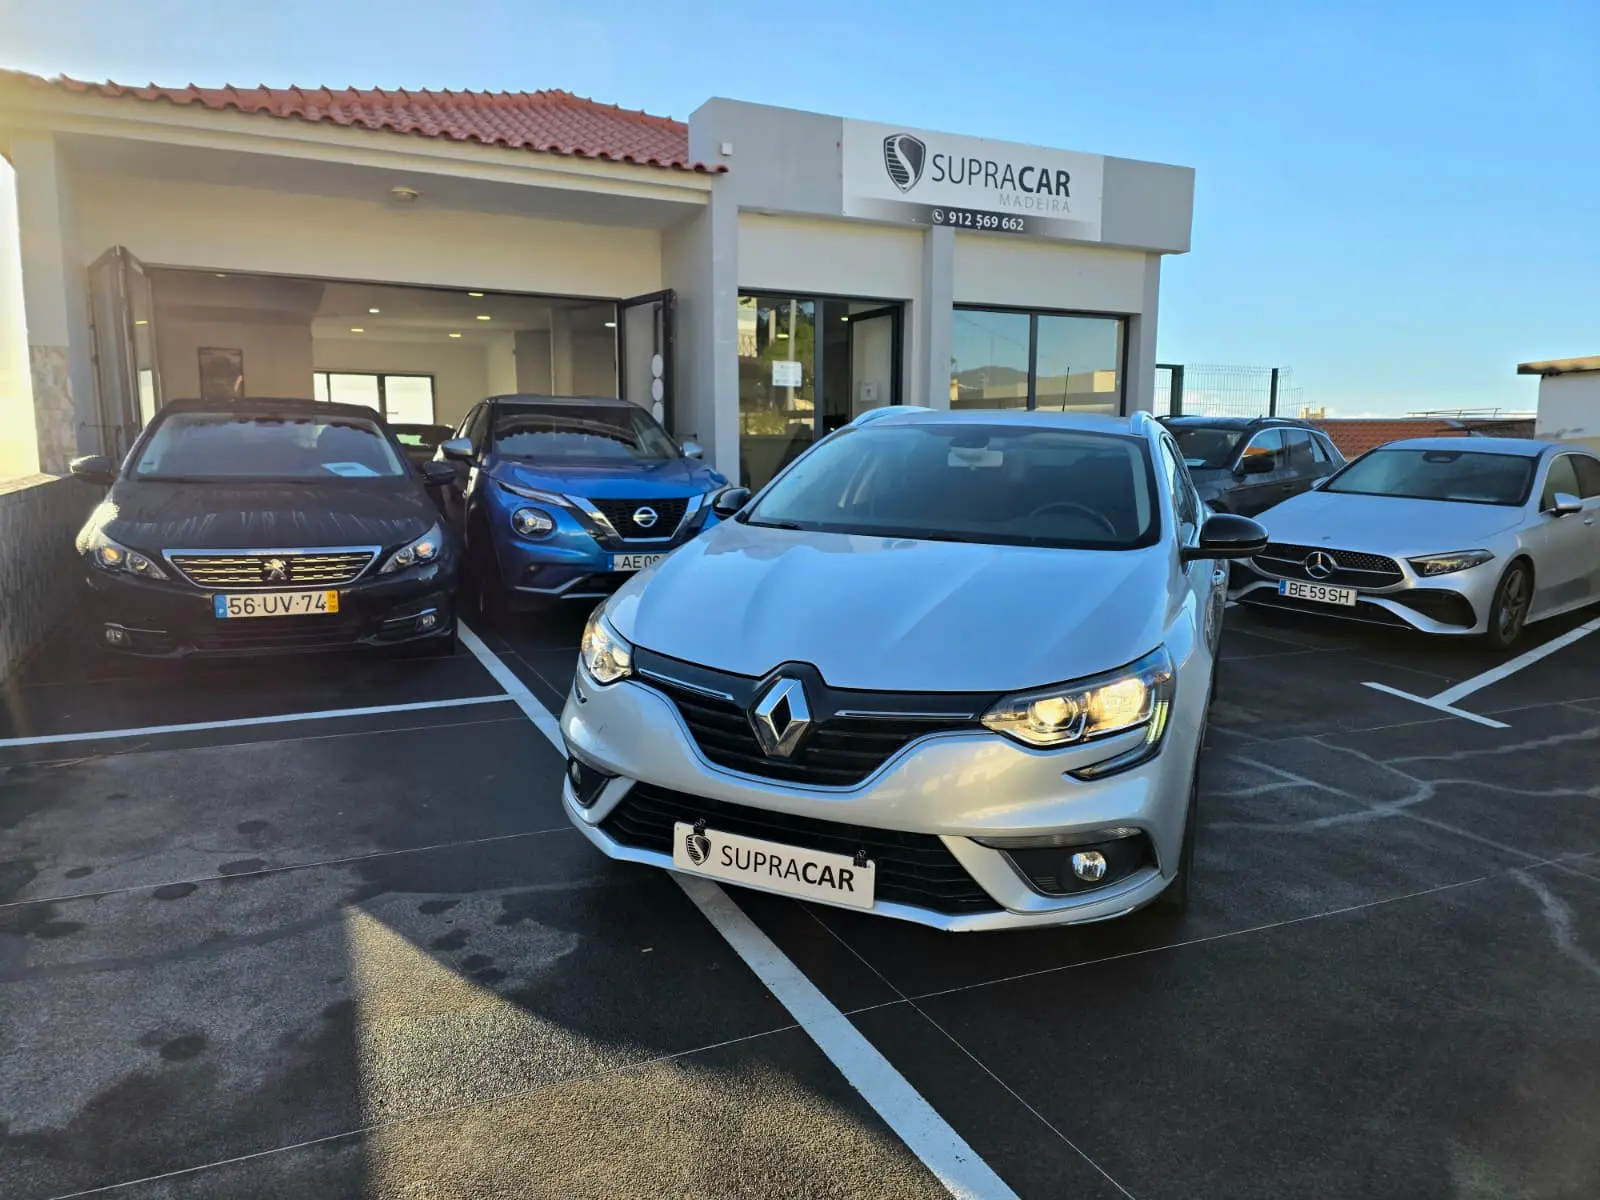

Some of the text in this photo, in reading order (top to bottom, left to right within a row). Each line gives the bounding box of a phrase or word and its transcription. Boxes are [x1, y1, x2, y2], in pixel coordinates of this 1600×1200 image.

[932, 154, 1071, 197] SUPRACAR
[1000, 194, 1071, 213] MADEIRA
[948, 211, 1024, 231] 912 569 662
[721, 845, 854, 892] SUPRACAR
